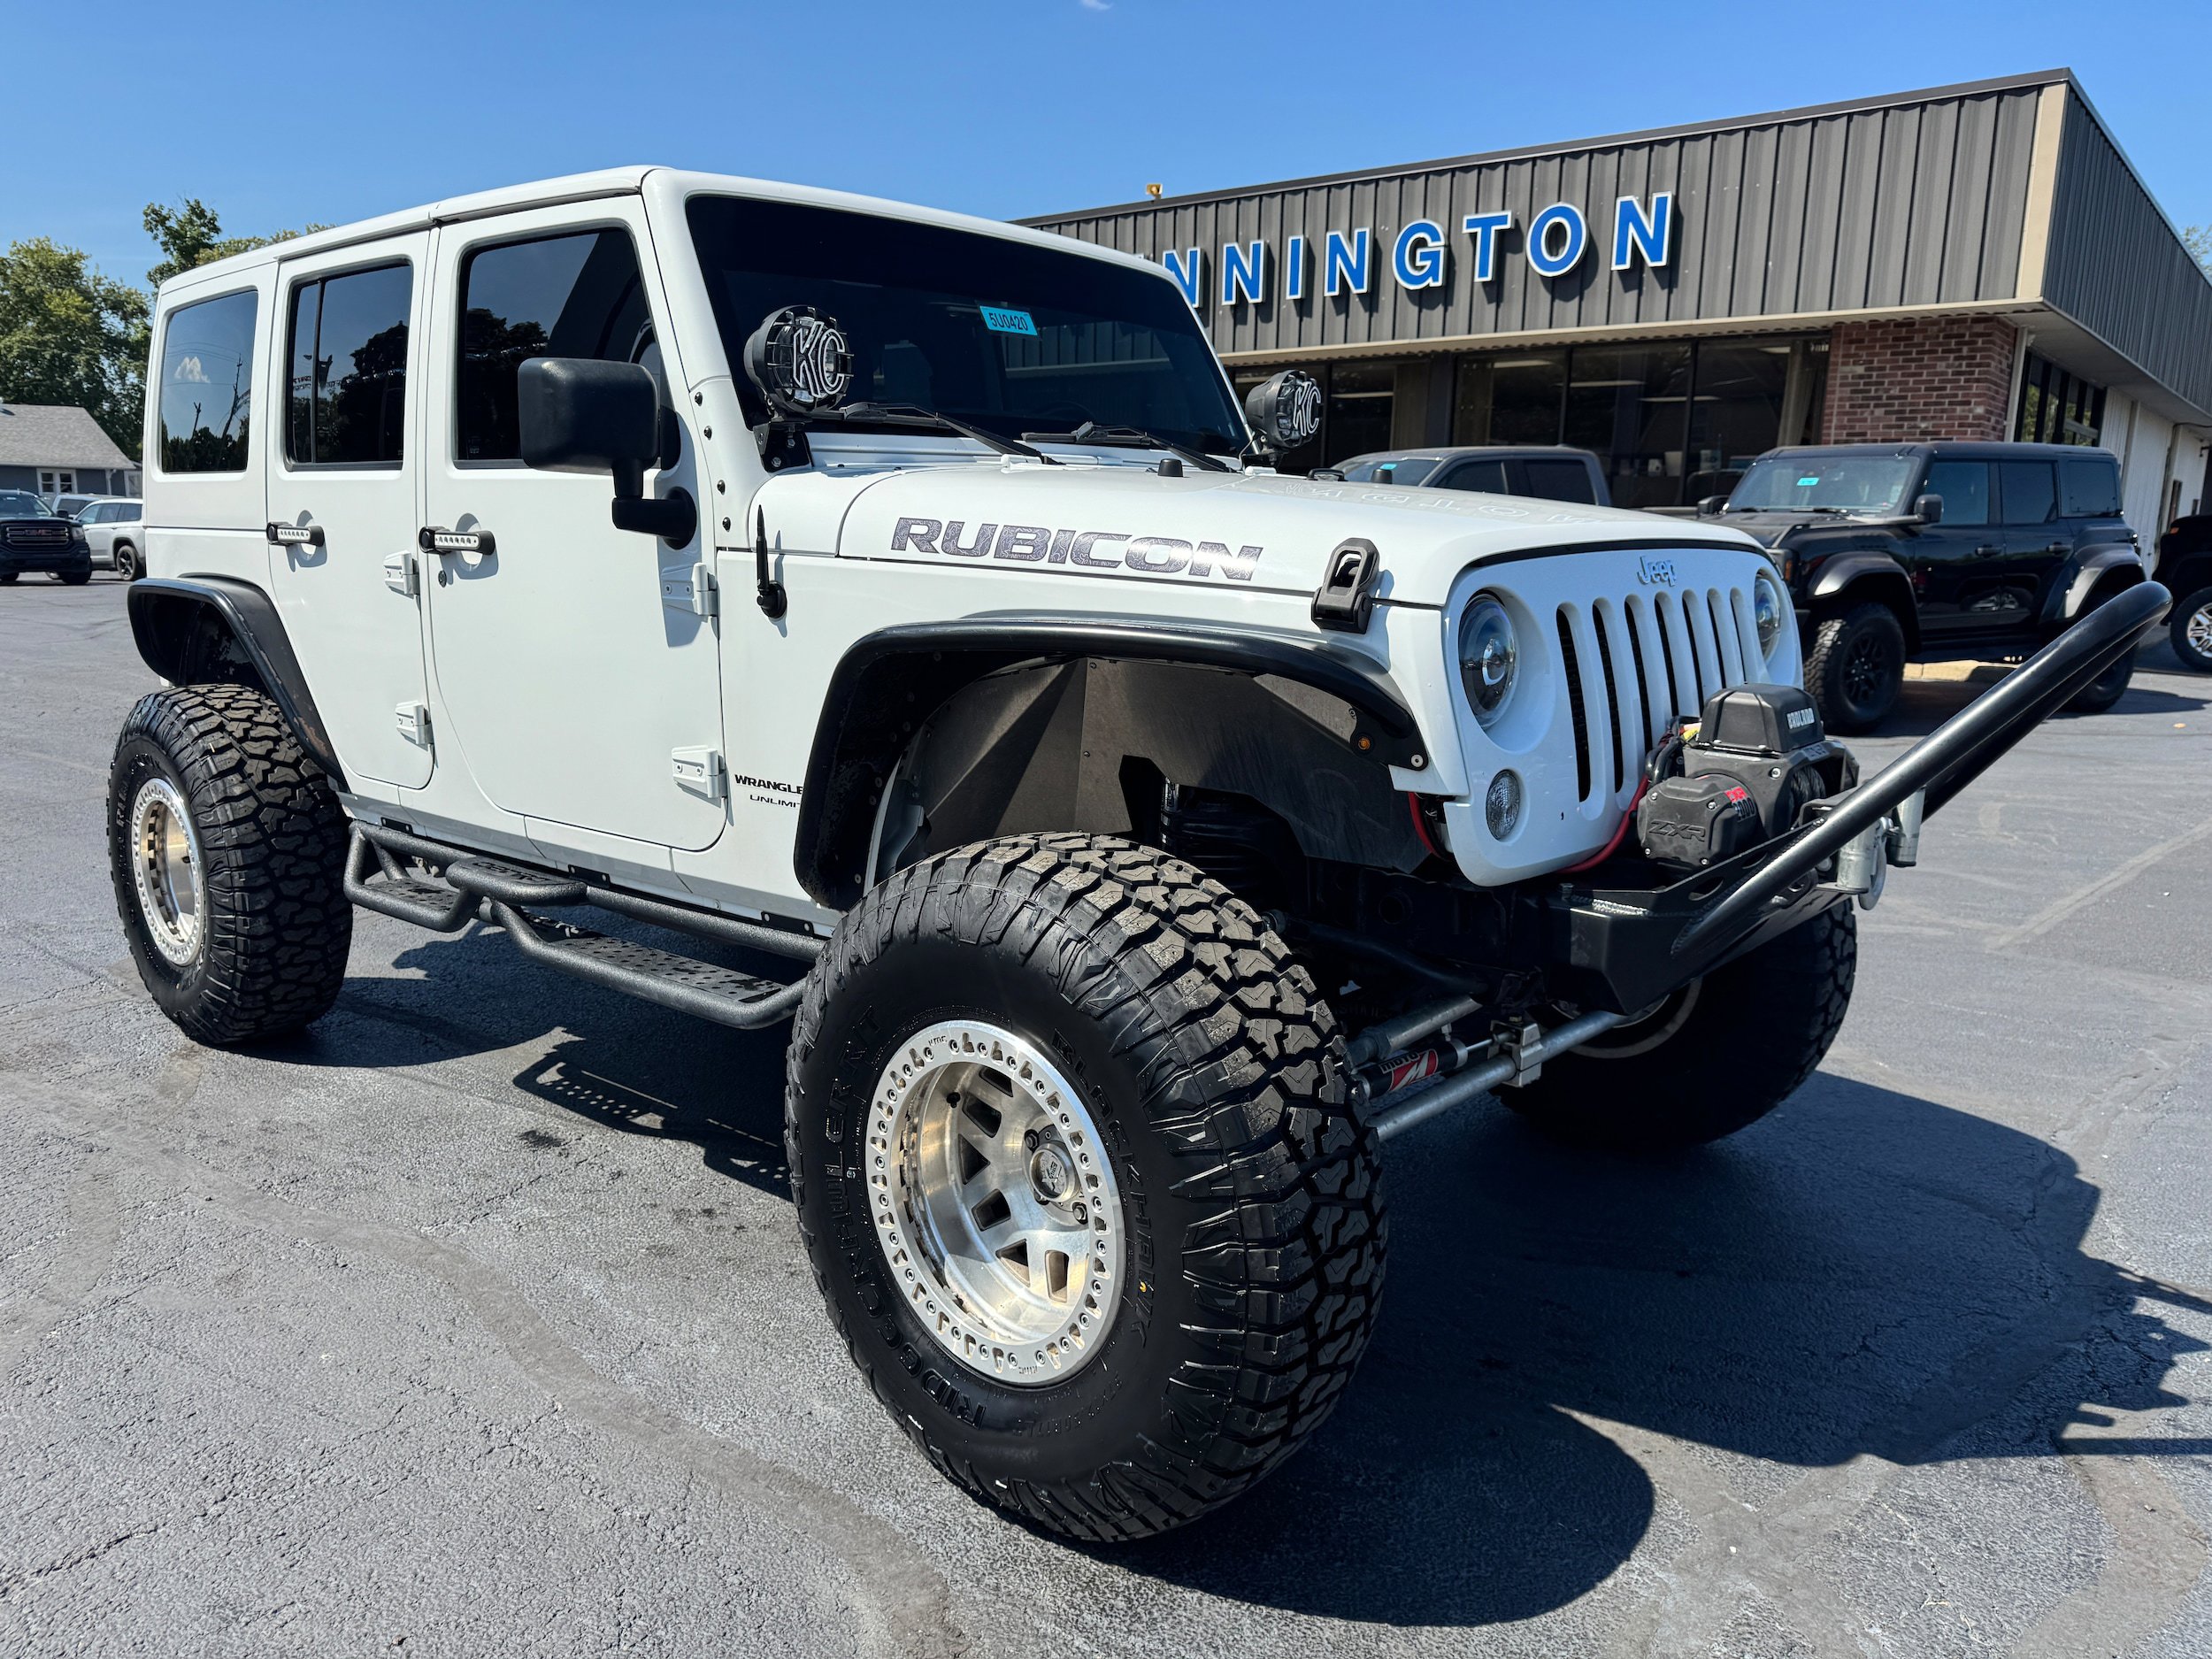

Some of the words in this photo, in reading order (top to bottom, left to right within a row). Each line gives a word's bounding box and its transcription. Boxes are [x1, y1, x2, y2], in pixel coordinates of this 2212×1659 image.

[1135, 191, 1675, 308] NNINGTON
[989, 311, 1028, 332] 5U0420
[793, 320, 846, 398] KC
[1293, 381, 1321, 436] KC
[891, 518, 1263, 580] RUBICON
[1637, 556, 1677, 587] Jeep
[734, 774, 803, 795] WRANGLE
